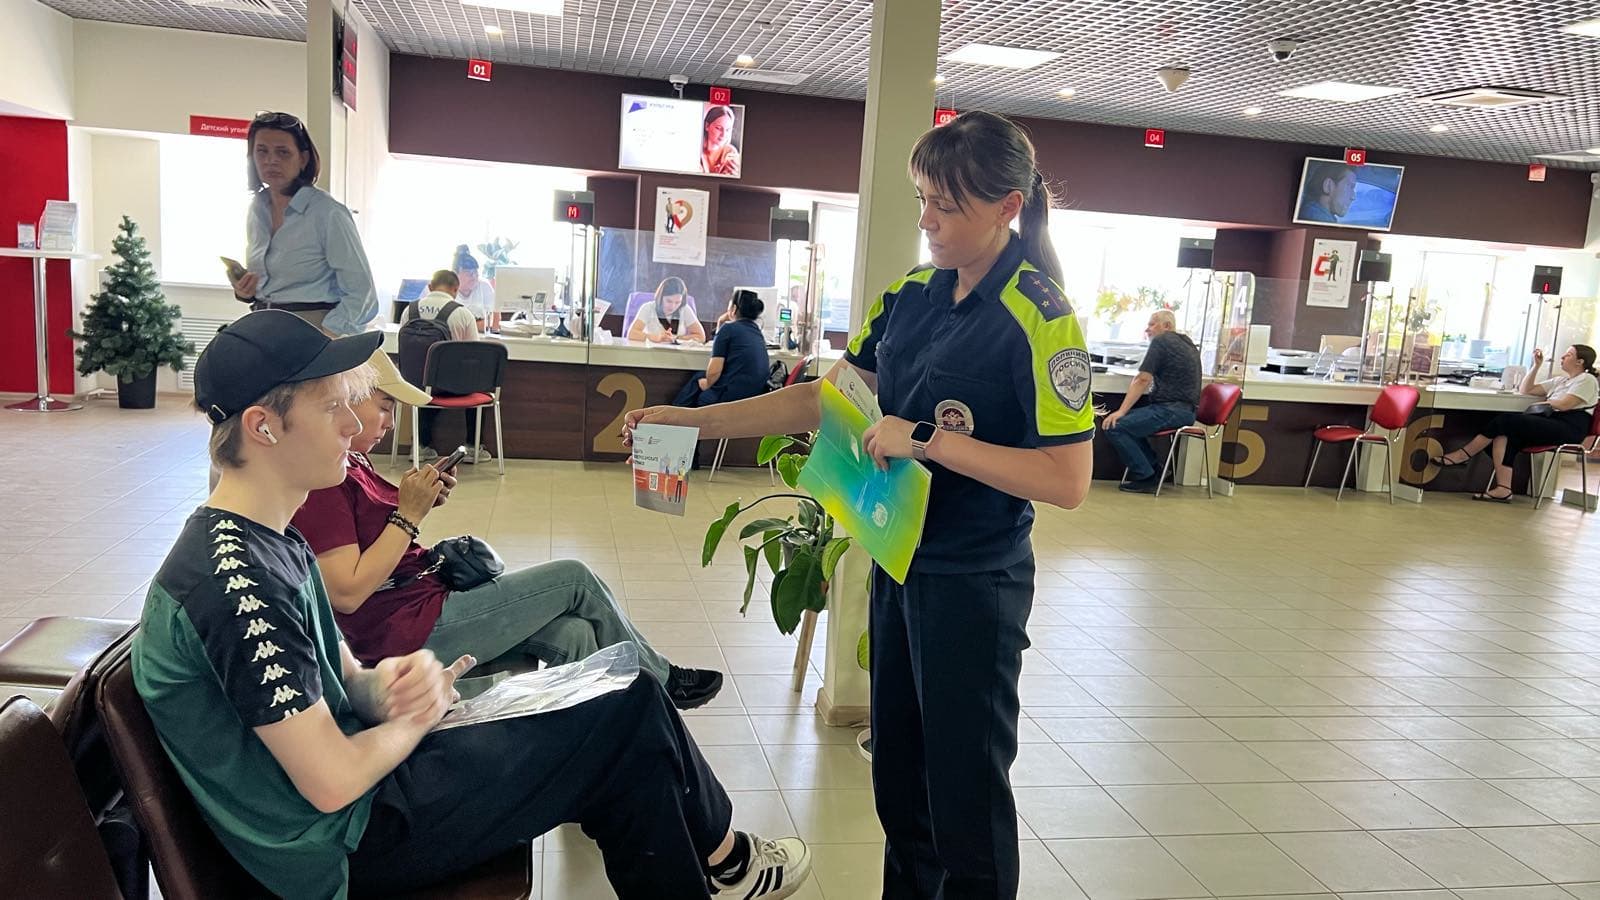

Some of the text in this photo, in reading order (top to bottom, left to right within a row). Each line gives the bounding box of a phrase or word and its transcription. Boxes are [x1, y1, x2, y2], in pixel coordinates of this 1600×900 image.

[473, 64, 486, 76] 01
[714, 93, 726, 101] 02
[1150, 133, 1160, 142] 04
[1351, 153, 1362, 163] 05
[1235, 285, 1248, 315] 4
[1055, 361, 1086, 378] РОССИЯ
[593, 372, 646, 454] 2
[1219, 405, 1269, 478] 5
[1400, 414, 1445, 485] 6
